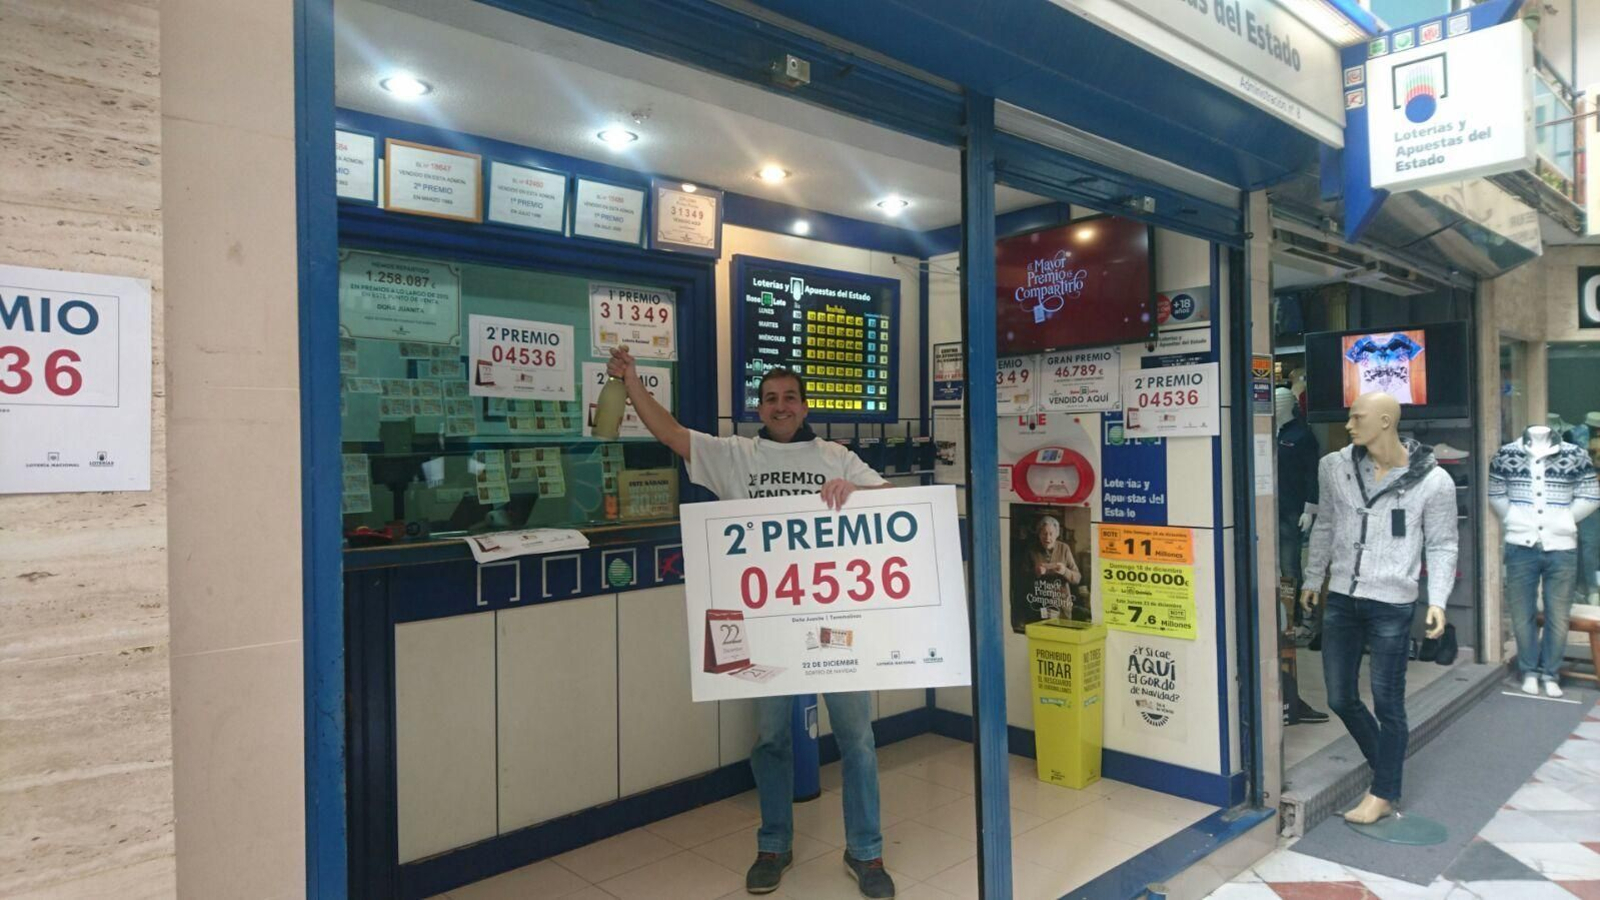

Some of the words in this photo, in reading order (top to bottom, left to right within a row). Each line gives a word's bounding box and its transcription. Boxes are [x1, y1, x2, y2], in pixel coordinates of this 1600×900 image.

[1214, 0, 1242, 37] del
[1246, 9, 1300, 72] Estado
[1458, 118, 1467, 132] y
[1395, 132, 1464, 158] Apuestas
[1468, 126, 1492, 144] del
[1395, 154, 1446, 173] Estado
[422, 183, 454, 195] PREMIO
[517, 199, 544, 209] PREMIO
[600, 213, 625, 223] PREMIO
[671, 206, 704, 220] 31349
[366, 269, 430, 288] 1.258.087
[1027, 269, 1067, 288] Premio
[361, 284, 390, 293] PREMIOS
[405, 289, 427, 298] LARGO
[619, 290, 661, 305] PREMIO
[753, 278, 784, 290] Loterías
[784, 283, 790, 293] y
[804, 285, 837, 297] Apuestas
[837, 288, 848, 298] del
[848, 289, 872, 302] Estado
[398, 304, 425, 314] JUANITA
[1173, 298, 1191, 309] +18
[600, 302, 669, 324] 31349
[758, 320, 779, 329] MARTES
[501, 327, 560, 346] PREMIO
[758, 334, 786, 342] MIÉRCOLES
[492, 345, 557, 367] 04536
[1047, 355, 1072, 367] GRAN
[1074, 352, 1111, 365] PREMIO
[0, 344, 83, 397] 36
[996, 371, 1030, 385] 349
[1055, 364, 1097, 378] 46.789
[1148, 372, 1203, 389] PREMIO
[1049, 396, 1085, 405] VENDIDO
[1086, 392, 1109, 403] AQUÍ
[1139, 389, 1199, 408] 04536
[760, 471, 826, 486] PREMIO
[1143, 480, 1150, 491] y
[762, 510, 918, 553] PREMIO
[1123, 538, 1152, 556] 11
[1155, 550, 1183, 559] Millones
[1109, 562, 1135, 572] Domingo
[1152, 565, 1183, 575] diciembre
[740, 556, 911, 610] 04536
[1161, 620, 1191, 630] Millones
[719, 624, 742, 645] 22
[822, 659, 859, 667] DICIEMBRE
[1036, 648, 1072, 663] PROHIBIDO
[1036, 659, 1072, 680] TIRAR
[1127, 654, 1176, 681] AQUÍ
[1141, 687, 1180, 702] Navidad?
